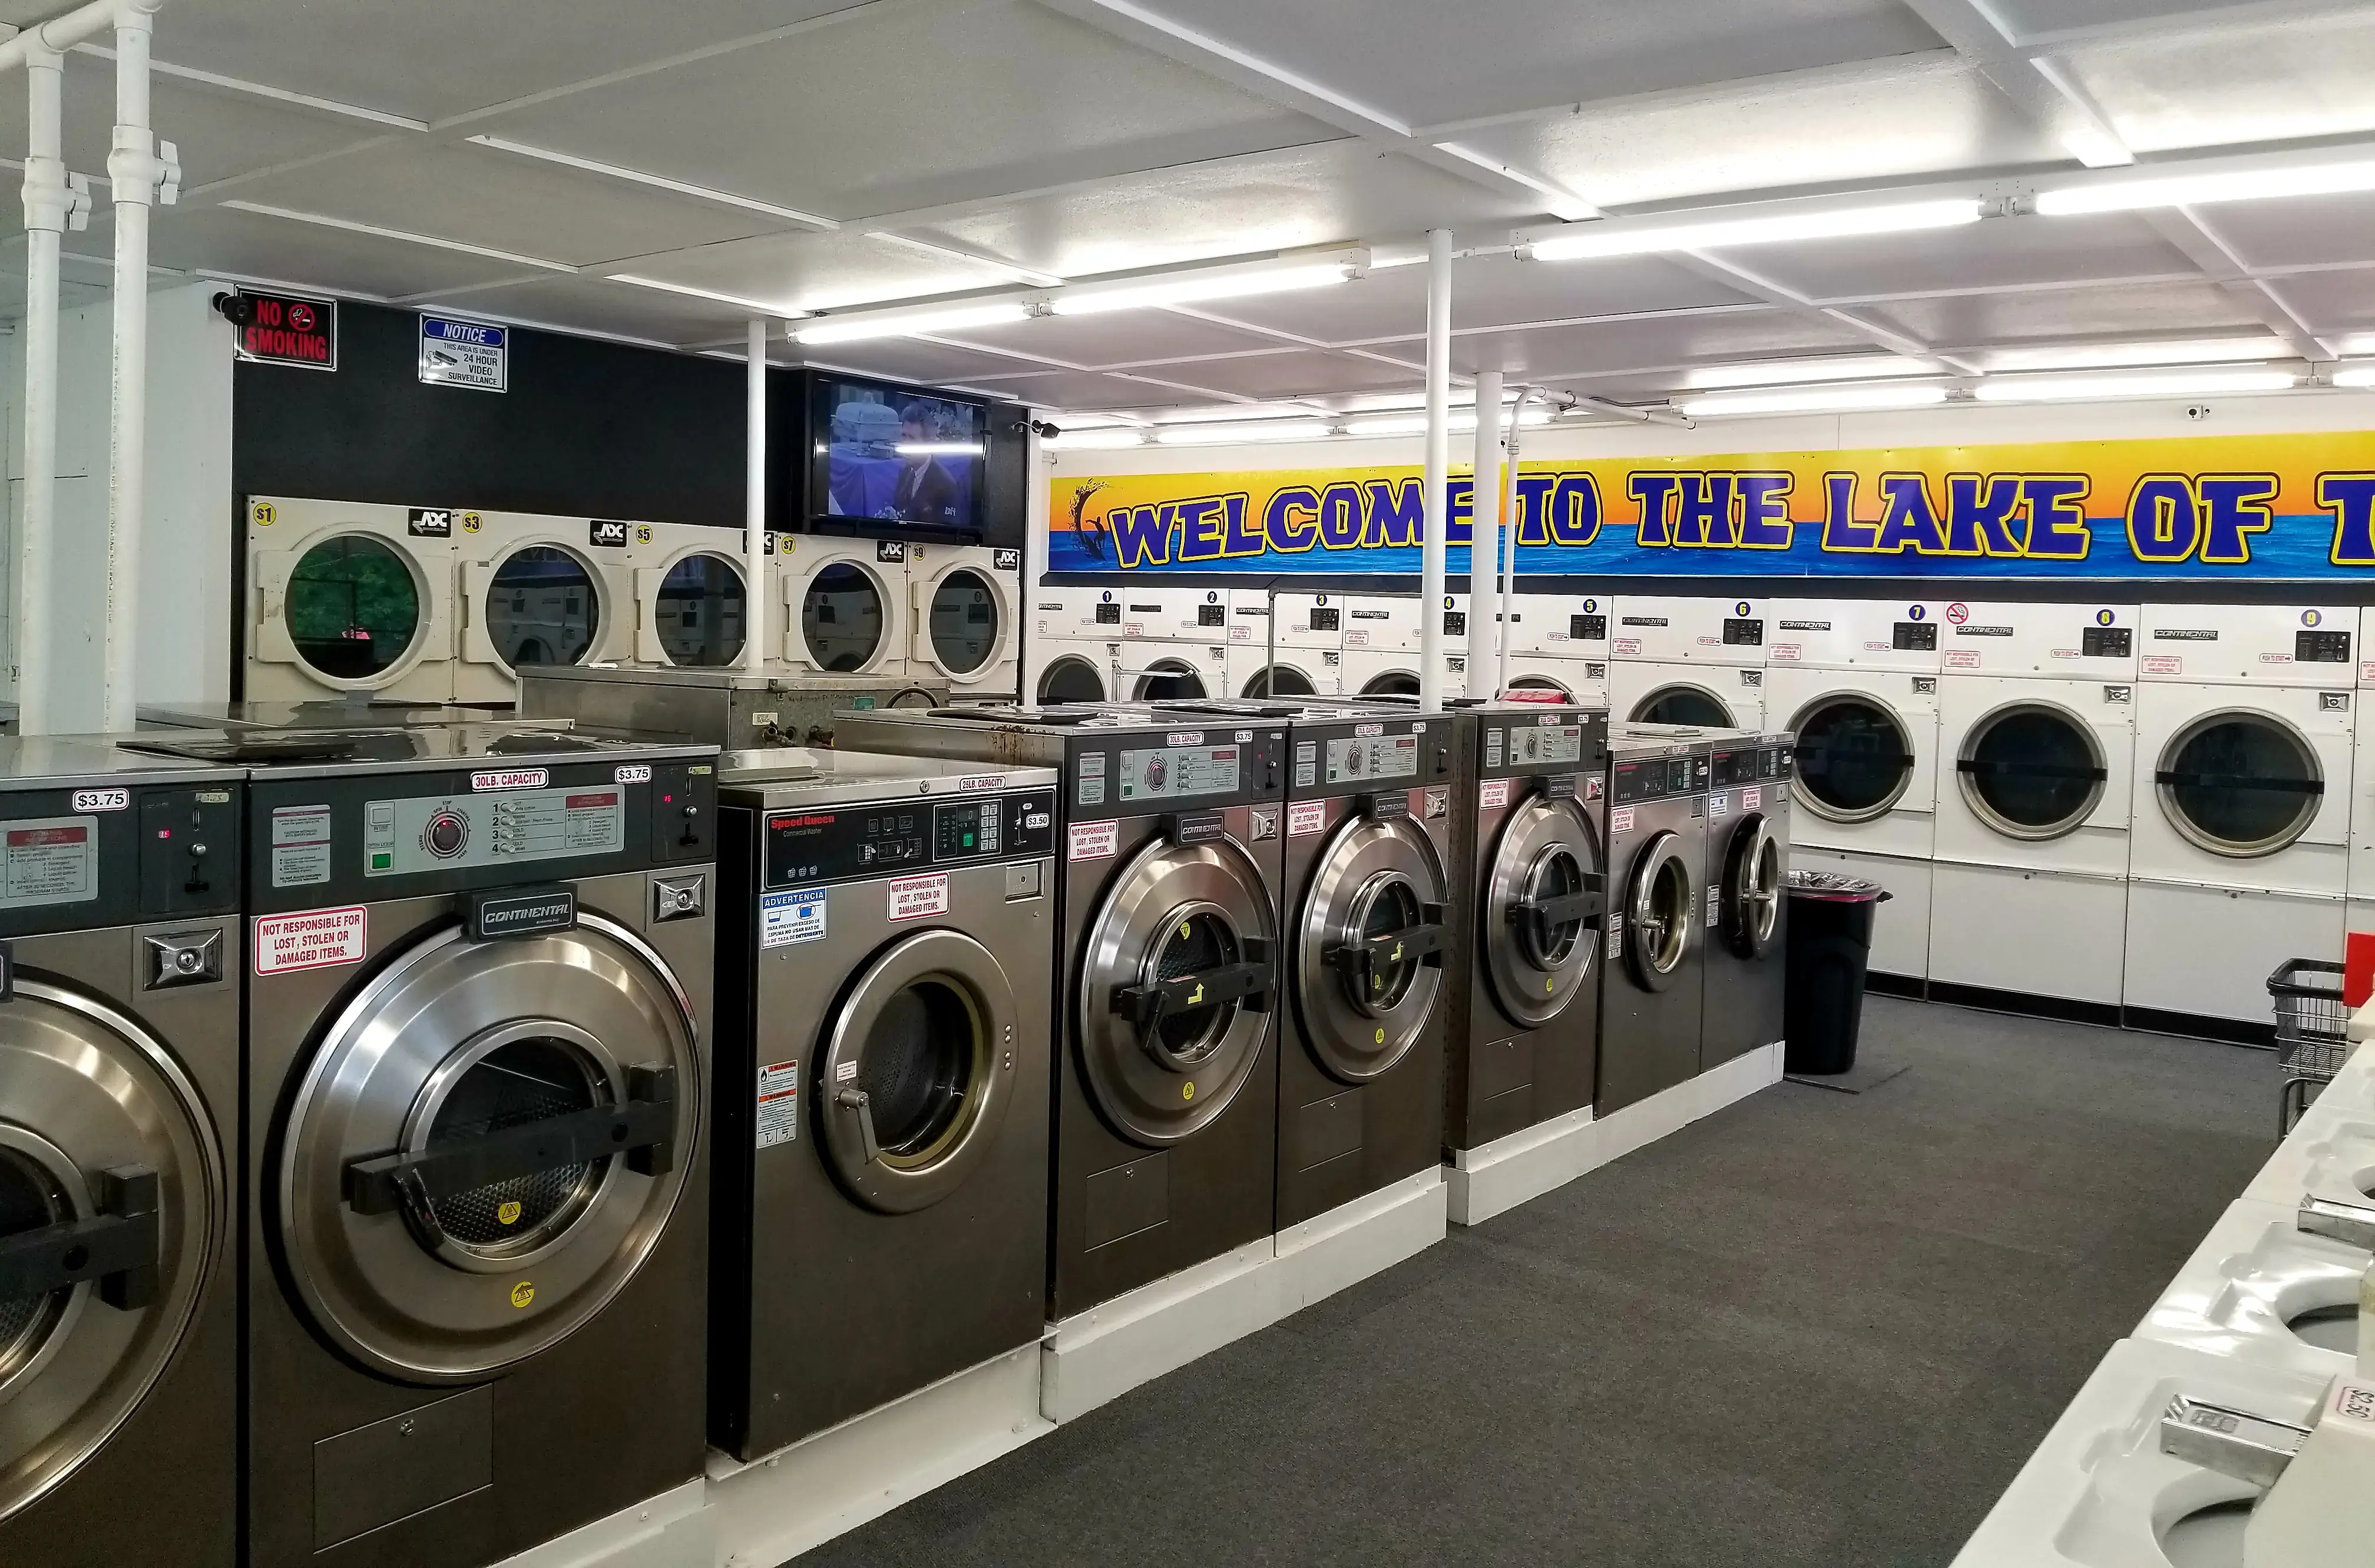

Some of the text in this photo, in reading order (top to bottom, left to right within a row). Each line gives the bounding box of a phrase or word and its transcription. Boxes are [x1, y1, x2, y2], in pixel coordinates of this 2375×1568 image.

[257, 299, 282, 326] NO
[443, 323, 487, 342] NOTICE
[246, 326, 326, 360] SMOKING
[479, 348, 498, 356] UNDER
[464, 353, 497, 366] 24 HOUR
[469, 364, 492, 376] VIDEO
[448, 372, 497, 386] SURVEILLANCE
[422, 511, 447, 527] ADC
[1508, 471, 1603, 547] TO
[1626, 470, 1795, 551] THE
[1821, 471, 2092, 561] LAKE
[2125, 471, 2281, 564] OF
[601, 523, 623, 538] ADC
[1105, 592, 1110, 601] 1
[1209, 593, 1215, 602] 2
[1319, 597, 1324, 605] 3
[1445, 598, 1451, 608] 4
[1586, 601, 1593, 611] 5
[1739, 604, 1746, 615] 6
[1914, 607, 1921, 618] 7
[2101, 611, 2109, 624] 8
[2307, 611, 2316, 625] 9
[1182, 734, 1202, 743] CAPACITY
[475, 772, 543, 787] 30LB. CAPACITY
[618, 769, 649, 780] $3.75
[962, 778, 1003, 789] 25LB. CAPACITY
[77, 793, 124, 808] $3.75
[493, 803, 498, 812] 1
[492, 816, 499, 826] 2
[771, 815, 835, 830] Speed Queen
[1028, 816, 1047, 826] $3.50
[492, 830, 499, 839] 3
[1072, 828, 1080, 837] NOT
[1080, 825, 1107, 835] RESPONSIBLE
[1089, 836, 1103, 844] STOLEN
[492, 843, 499, 853] 4
[1077, 847, 1096, 856] DAMAGED
[891, 878, 946, 893] NOT RESPONSIBLE FOR
[765, 891, 824, 907] ADVERTENCIA
[914, 891, 932, 901] STOLEN
[933, 890, 940, 898] OR
[485, 904, 569, 924] CONTINENTAL
[898, 901, 939, 915] DAMAGED ITEMS.
[263, 914, 360, 937] NOT RESPONSIBLE FOR
[302, 932, 335, 947] STOLEN
[337, 930, 349, 942] OR
[275, 945, 347, 965] DAMAGED ITEMS.
